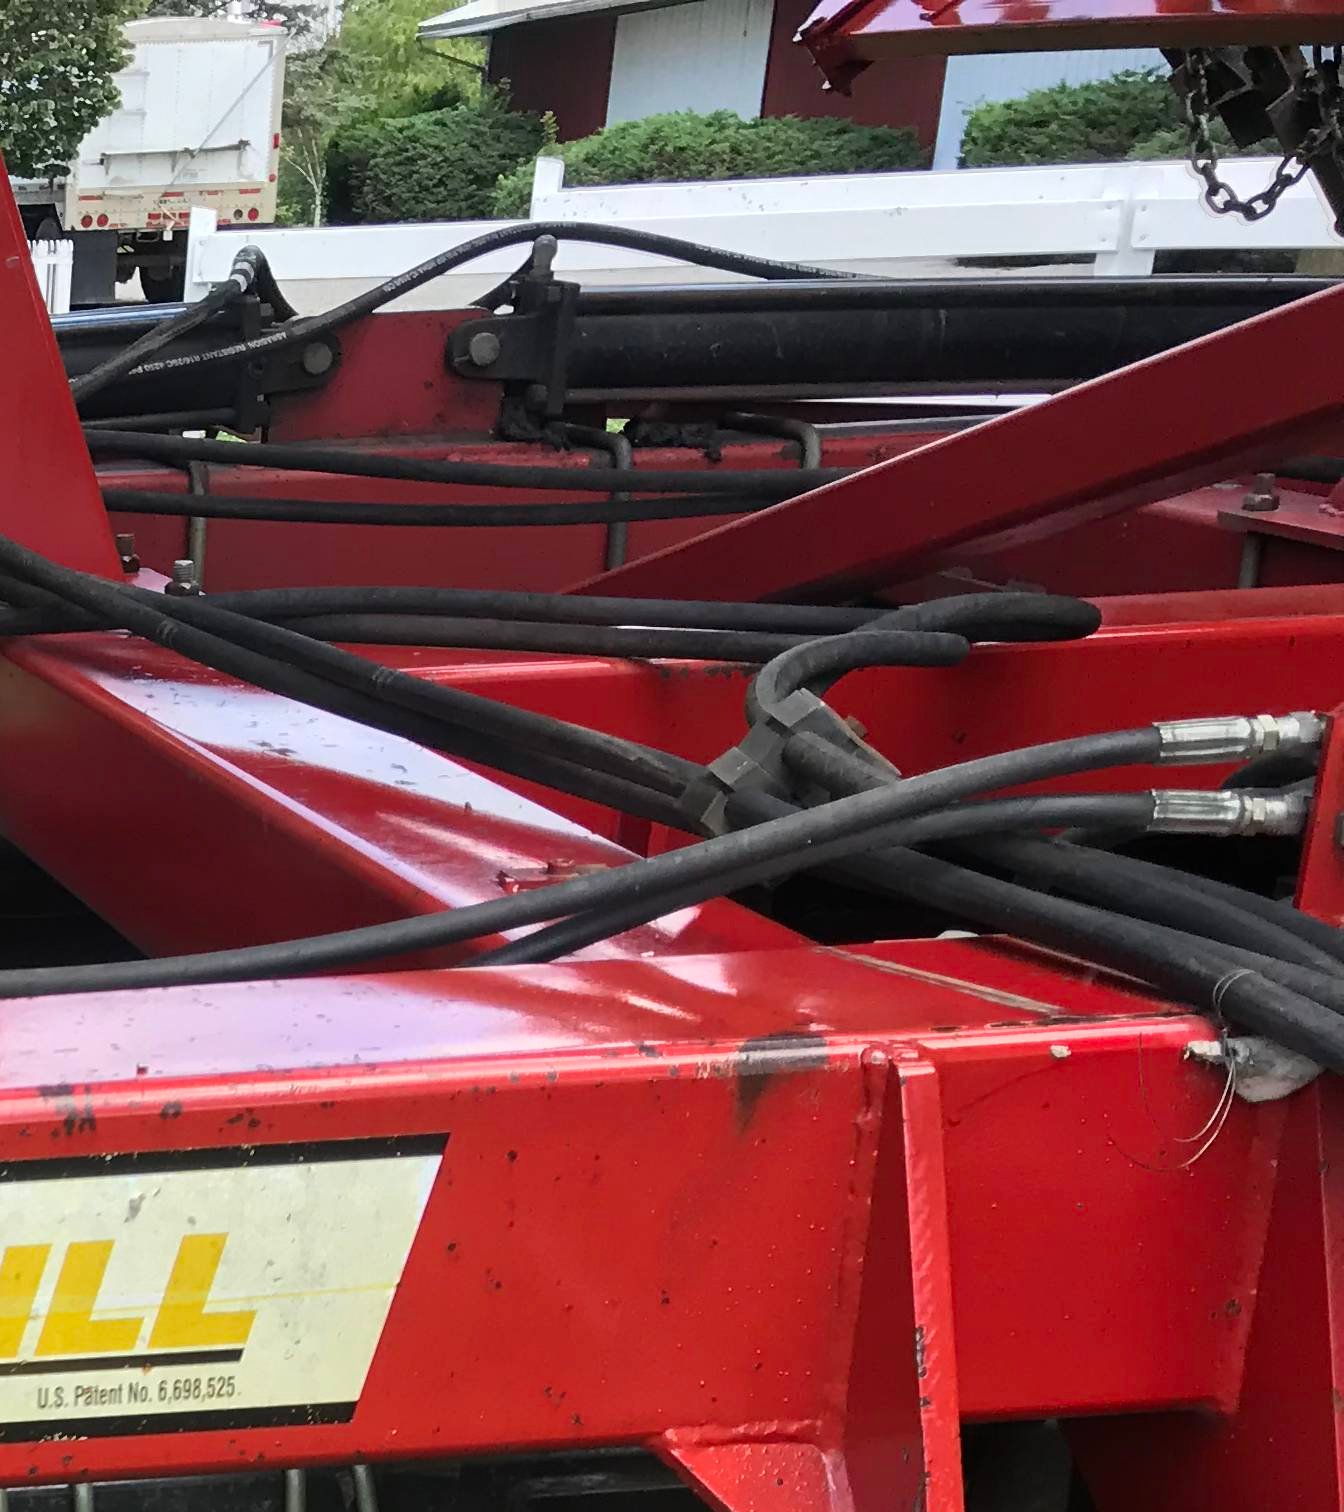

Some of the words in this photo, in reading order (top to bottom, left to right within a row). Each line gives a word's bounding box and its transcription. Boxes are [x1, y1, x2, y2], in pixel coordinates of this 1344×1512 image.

[37, 1386, 69, 1409] U.S.
[74, 1383, 123, 1407] Patent
[127, 1381, 153, 1403] No.
